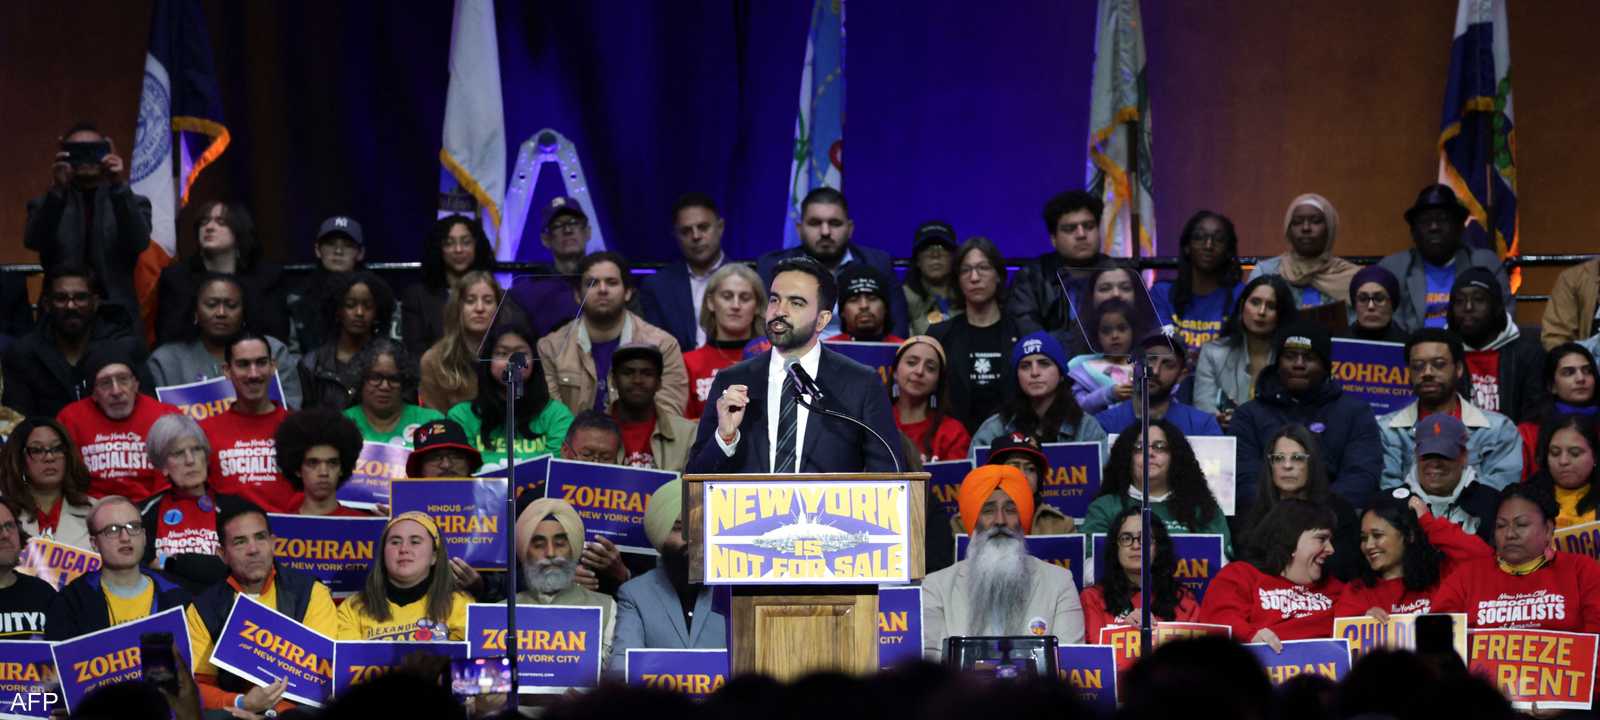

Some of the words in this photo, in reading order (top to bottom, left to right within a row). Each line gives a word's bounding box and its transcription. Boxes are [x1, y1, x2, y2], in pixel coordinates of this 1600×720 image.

[81, 442, 147, 456] DEMOCRAT
[218, 447, 277, 460] DEMOCRA
[220, 456, 277, 477] SOCIALI
[711, 487, 794, 536] NEW
[799, 487, 902, 536] YORK
[434, 515, 498, 533] HRAN
[273, 538, 374, 560] ZOHRAN
[794, 540, 823, 556] IS
[291, 562, 314, 570] NEW
[317, 563, 343, 571] YORK
[711, 544, 764, 578] NOT
[772, 557, 827, 578] FOR
[834, 544, 902, 578] SALE
[1478, 594, 1565, 609] DEMOCRATIC
[1477, 603, 1565, 625] SOCIALISTS
[239, 619, 333, 679] ZOHRAN
[879, 636, 904, 645] CITY
[1471, 634, 1574, 667] FREEZE
[74, 647, 142, 683] ZOHR
[253, 648, 277, 663] NEW
[277, 660, 303, 677] YORK
[303, 673, 326, 685] CITY
[527, 654, 555, 663] YORK
[556, 655, 580, 664] CITY
[641, 674, 725, 695] ZOHRA
[1496, 664, 1586, 697] RENT
